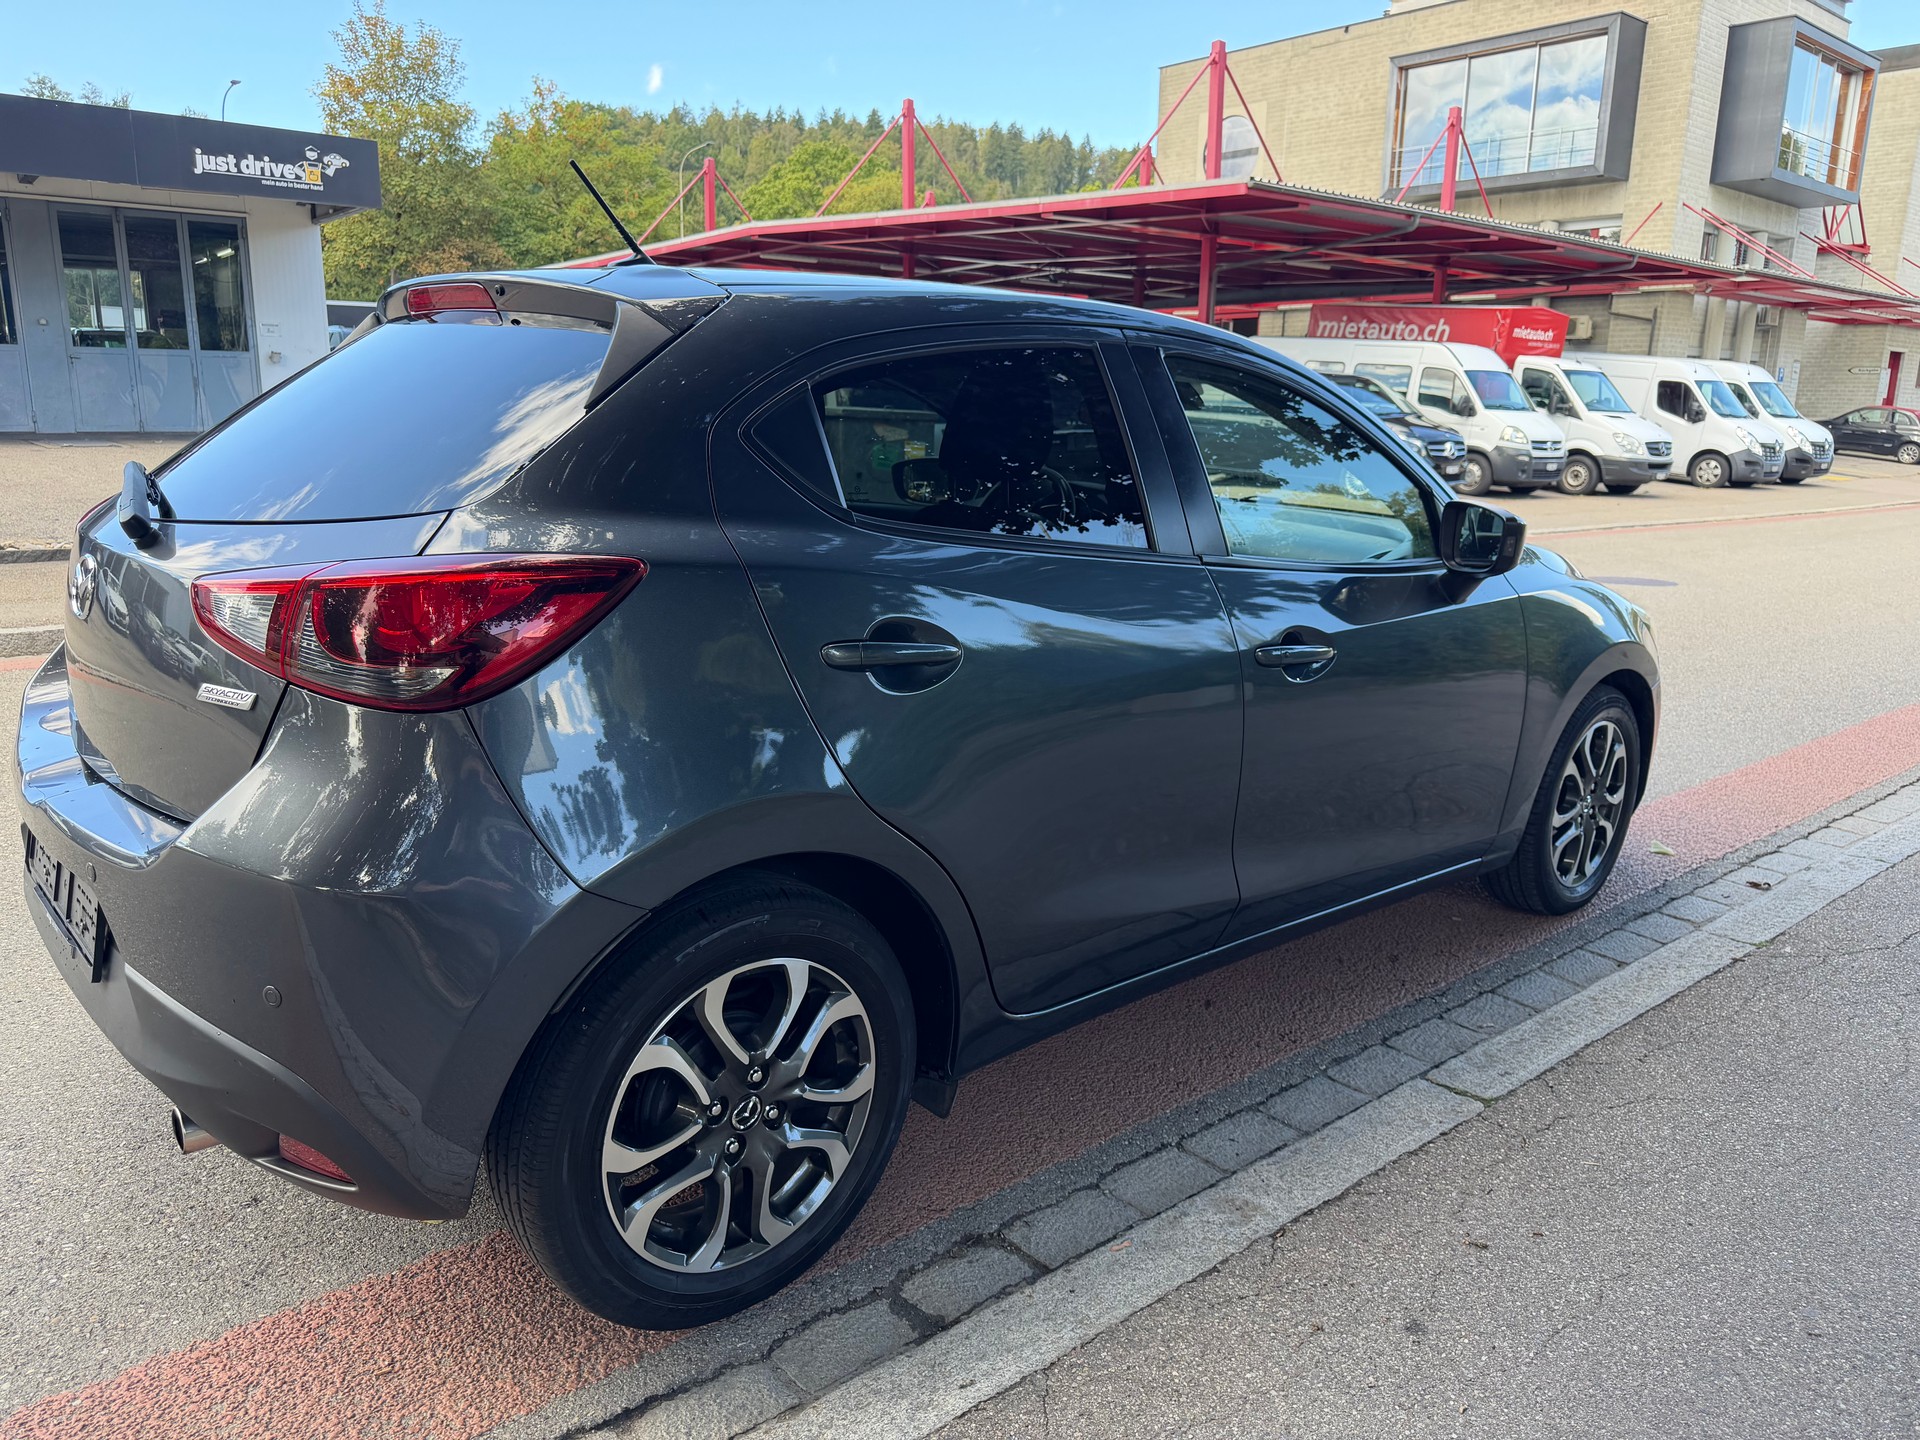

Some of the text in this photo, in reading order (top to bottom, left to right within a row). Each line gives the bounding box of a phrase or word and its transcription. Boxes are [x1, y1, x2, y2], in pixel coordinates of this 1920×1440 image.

[194, 147, 296, 179] just drive
[310, 183, 324, 191] hand
[1316, 315, 1450, 341] mietauto.ch
[1512, 325, 1554, 341] mietauto.ch
[202, 686, 252, 701] SKYACTIV
